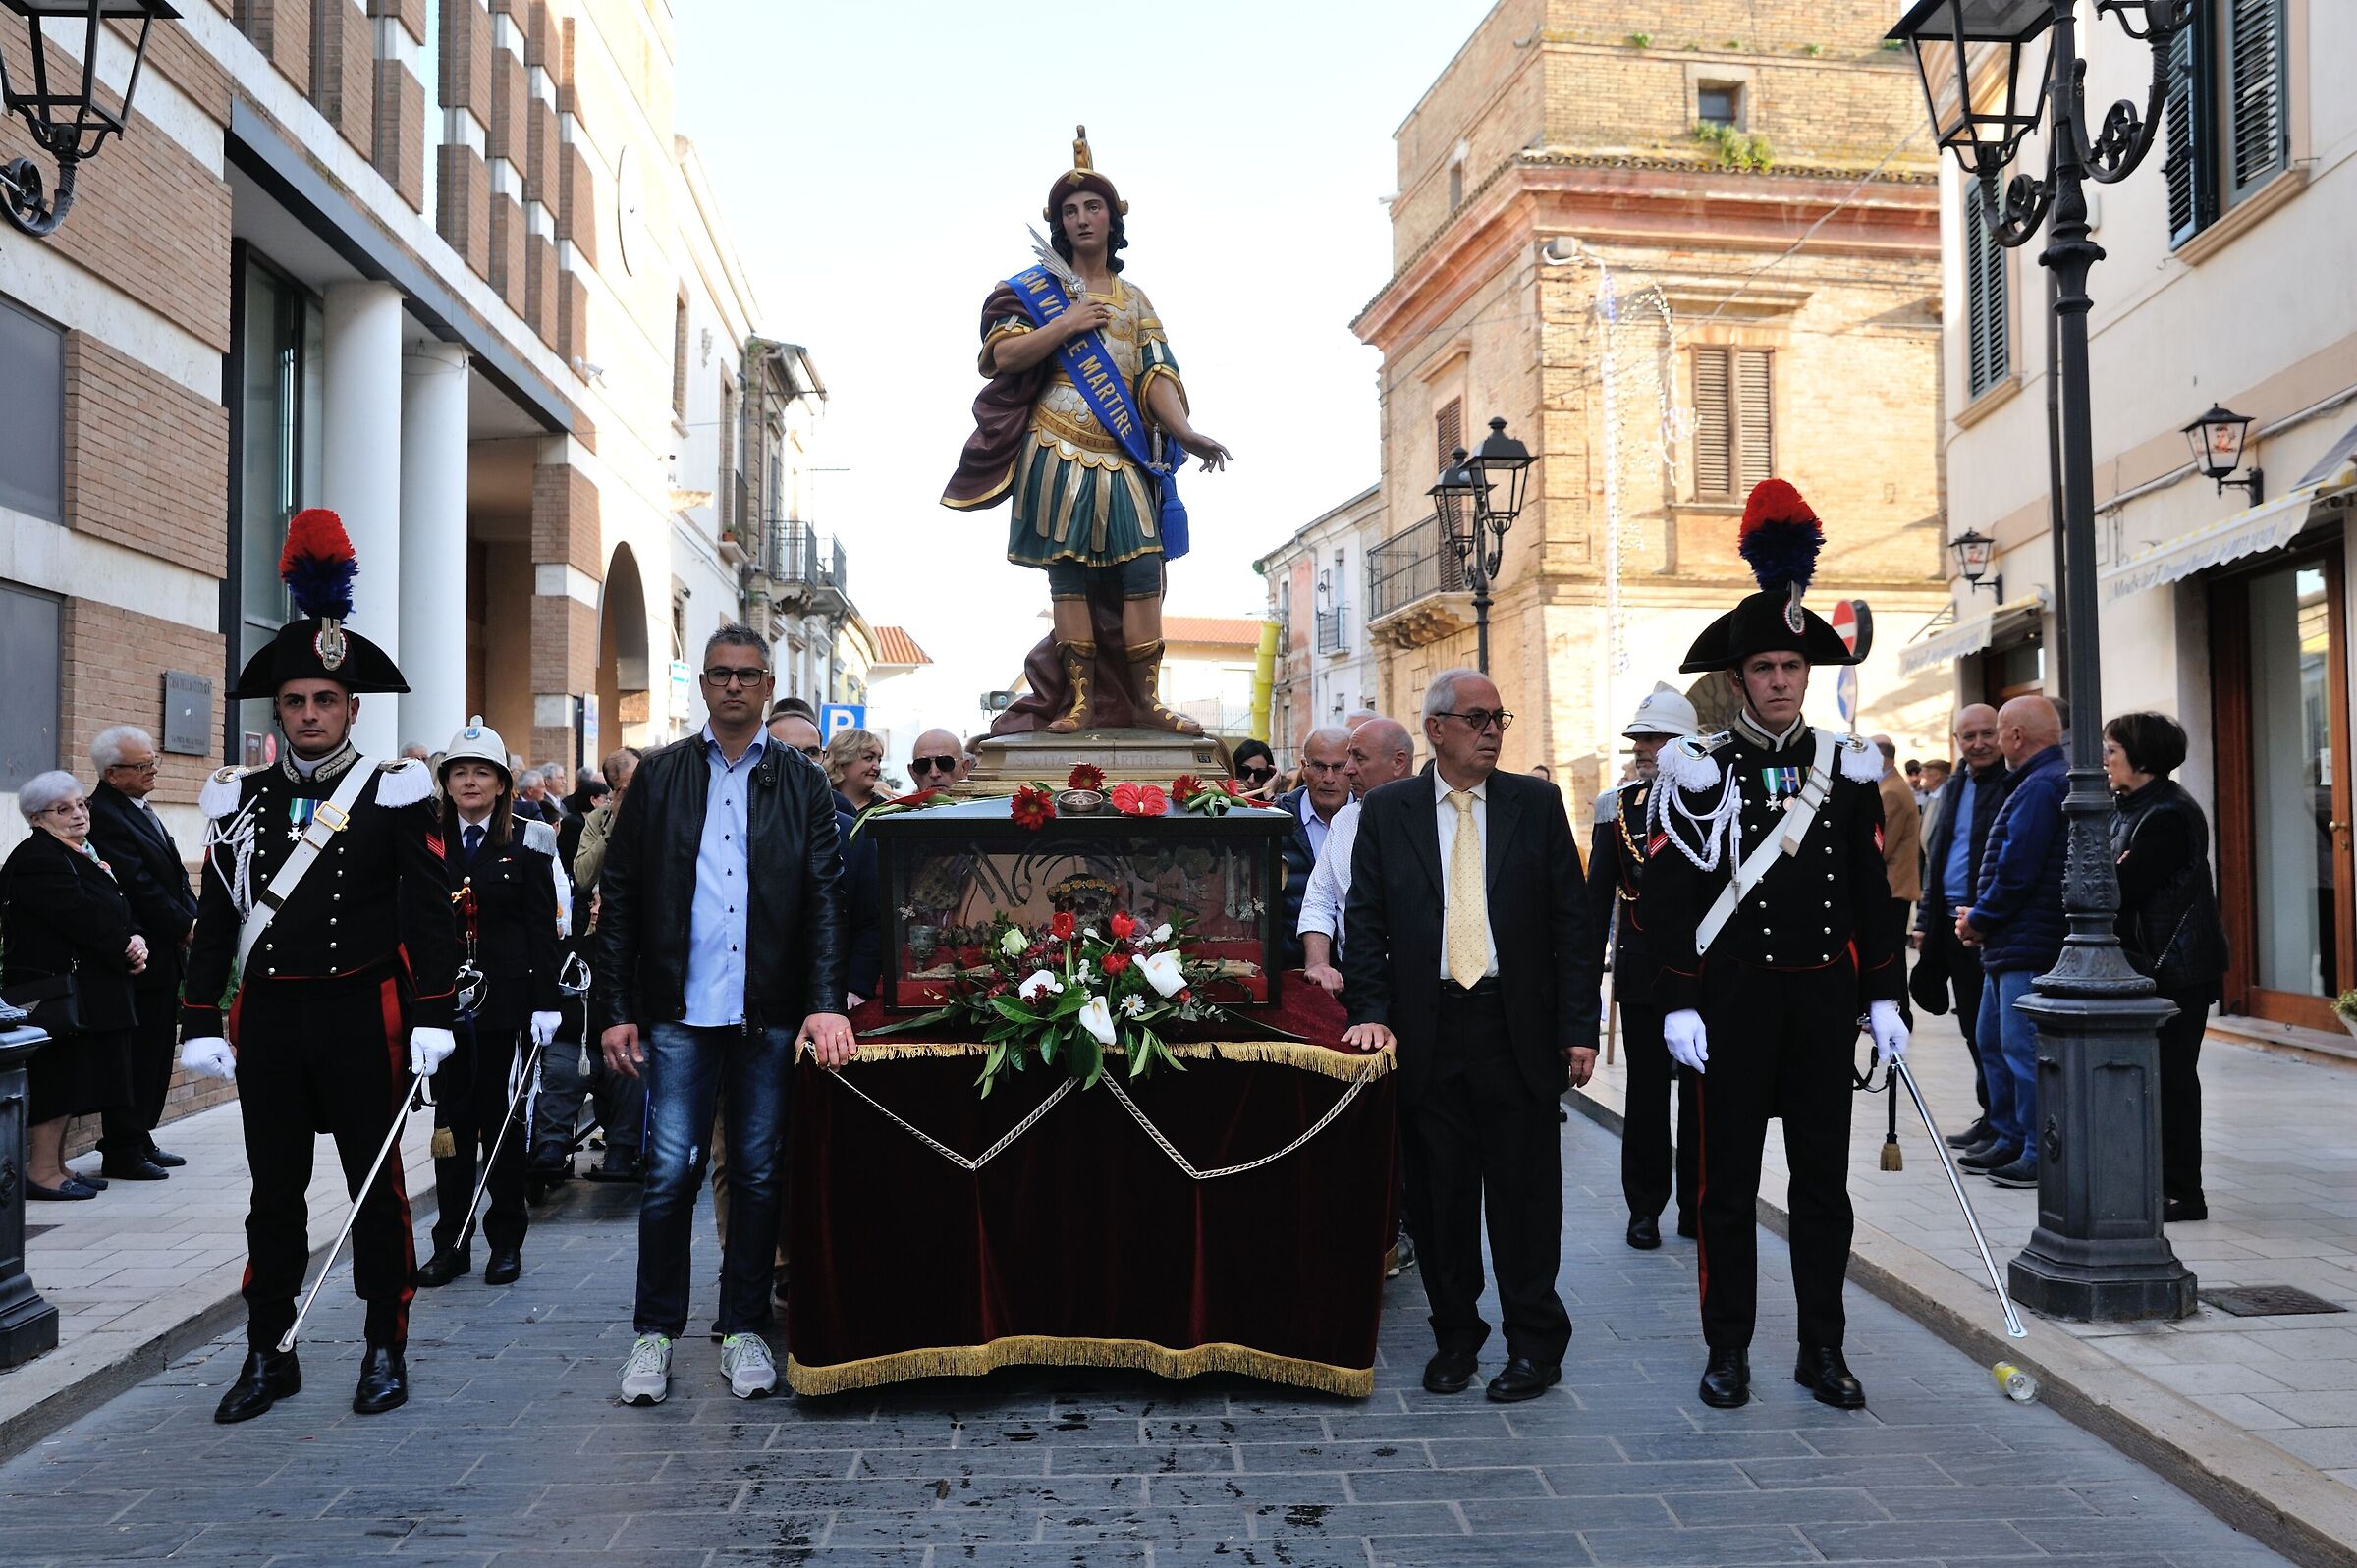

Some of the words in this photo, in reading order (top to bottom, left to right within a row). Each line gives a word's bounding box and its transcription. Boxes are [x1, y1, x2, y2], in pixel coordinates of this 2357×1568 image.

[1078, 355, 1133, 441] MARTIRE
[828, 709, 855, 741] P
[1015, 754, 1029, 767] S.
